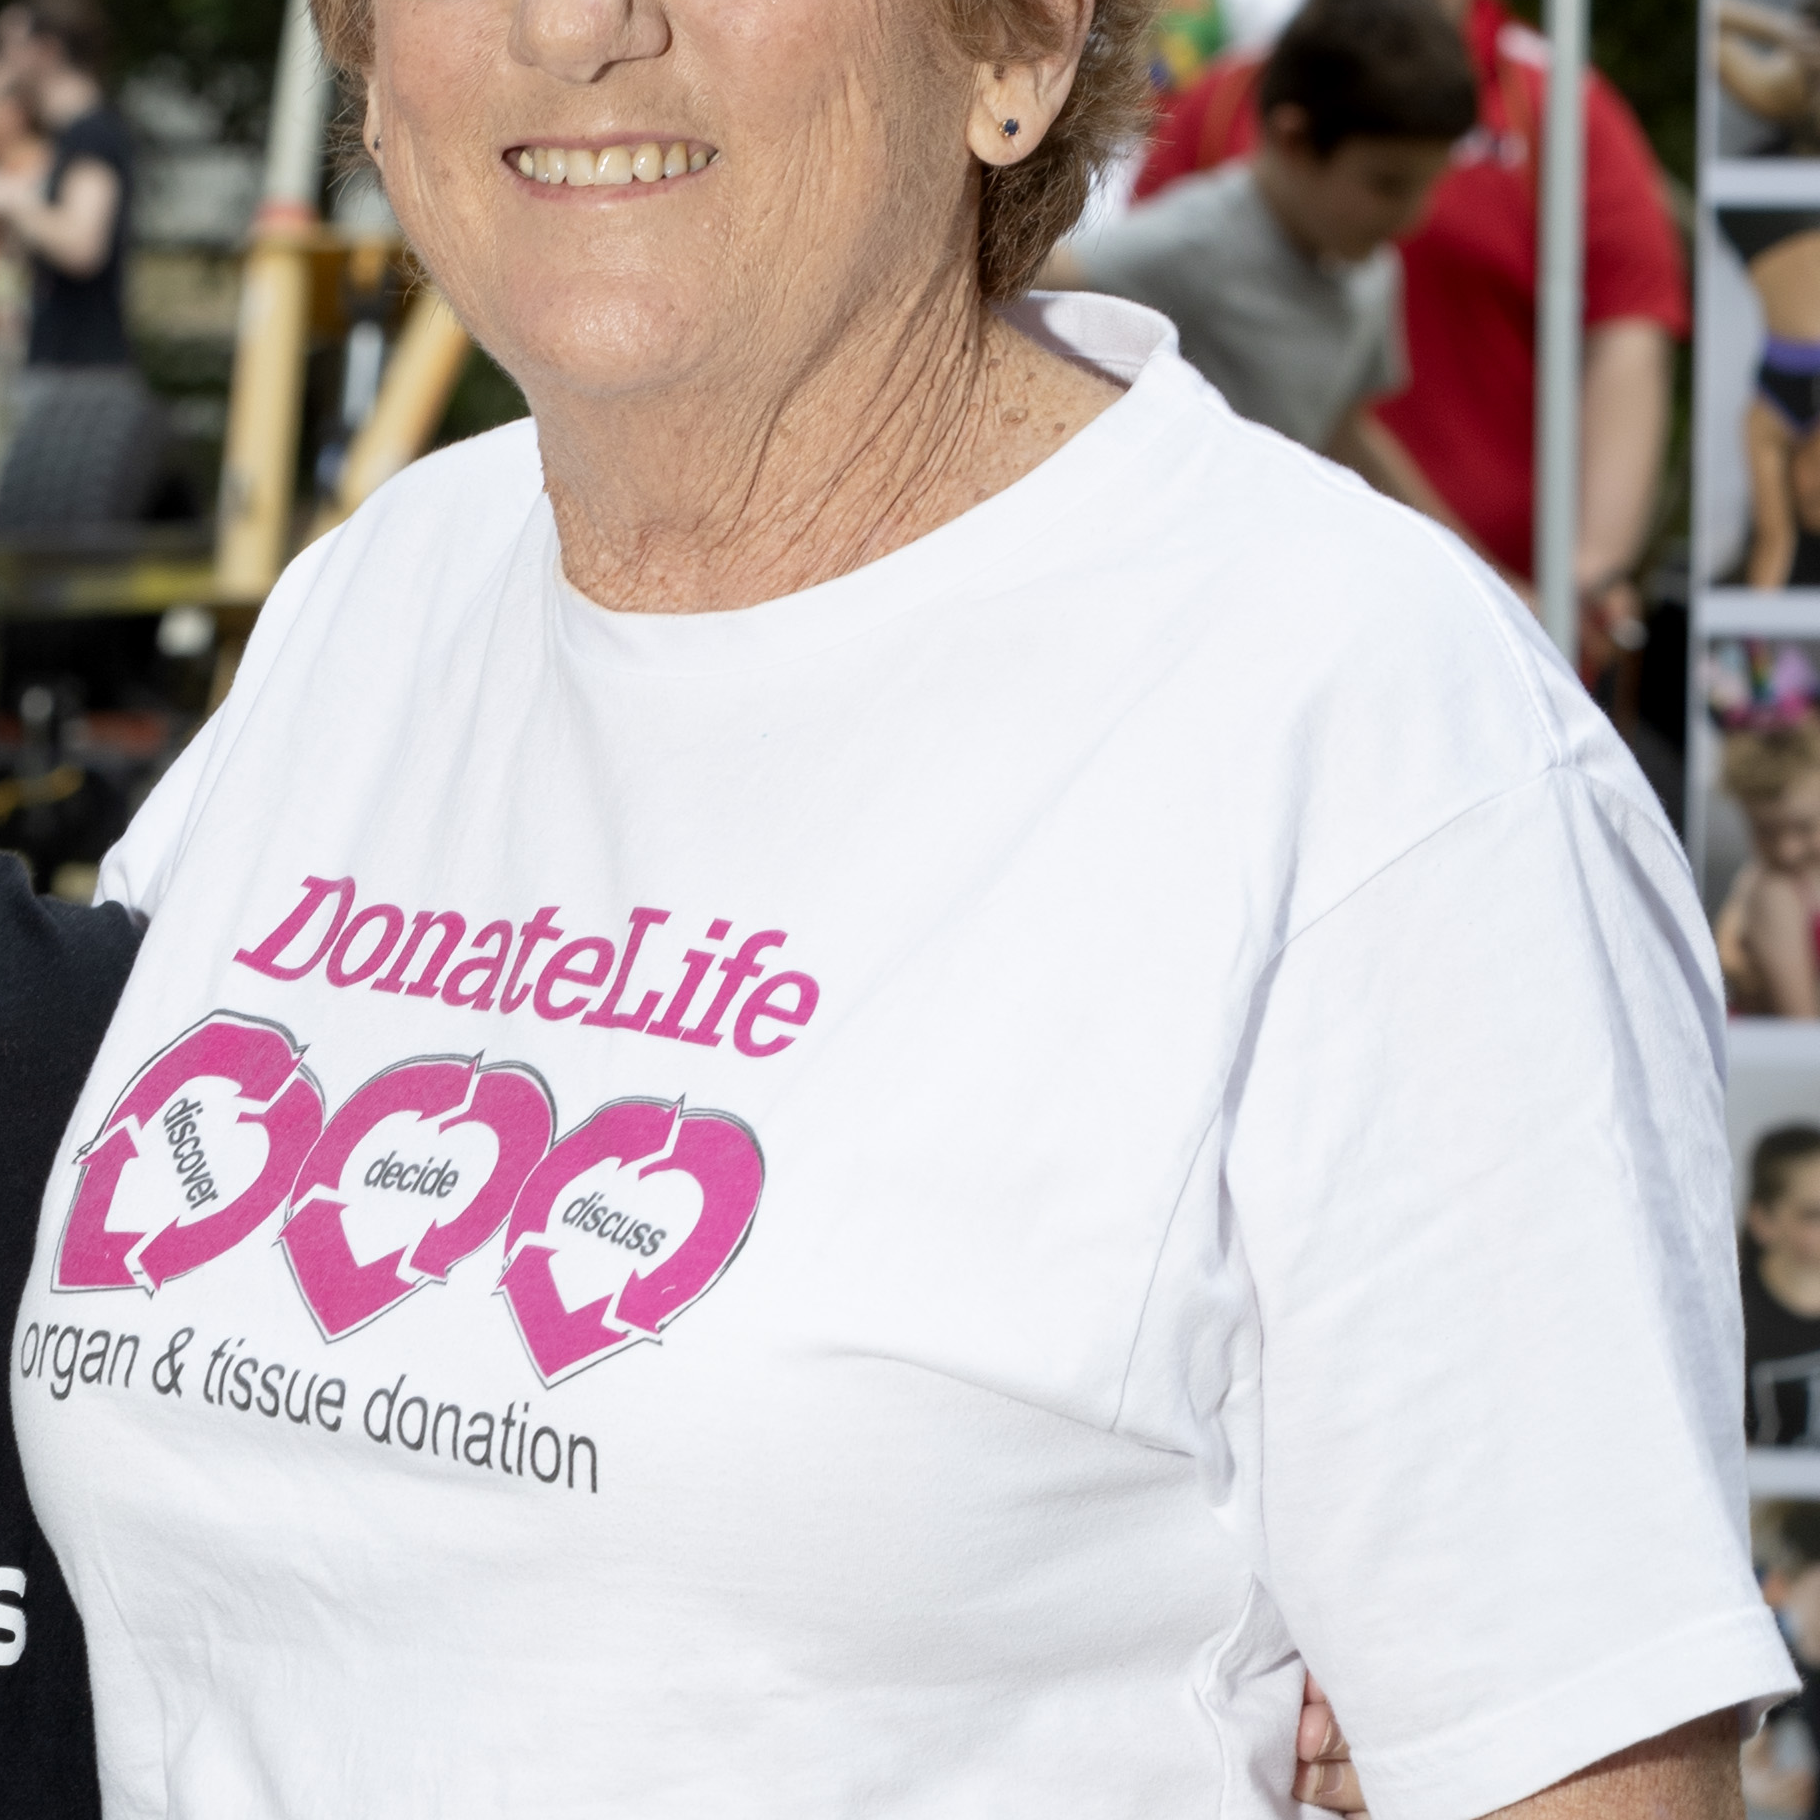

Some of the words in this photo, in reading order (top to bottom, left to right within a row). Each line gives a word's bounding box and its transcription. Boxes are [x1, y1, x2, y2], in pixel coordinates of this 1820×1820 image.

[233, 875, 820, 1058] DonateLife
[162, 1096, 220, 1211] discover
[363, 1151, 460, 1198] decide
[561, 1192, 666, 1257] discuss
[20, 1321, 140, 1402] organ
[151, 1326, 194, 1398] &
[202, 1337, 347, 1433] tissue
[362, 1373, 602, 1494] donation
